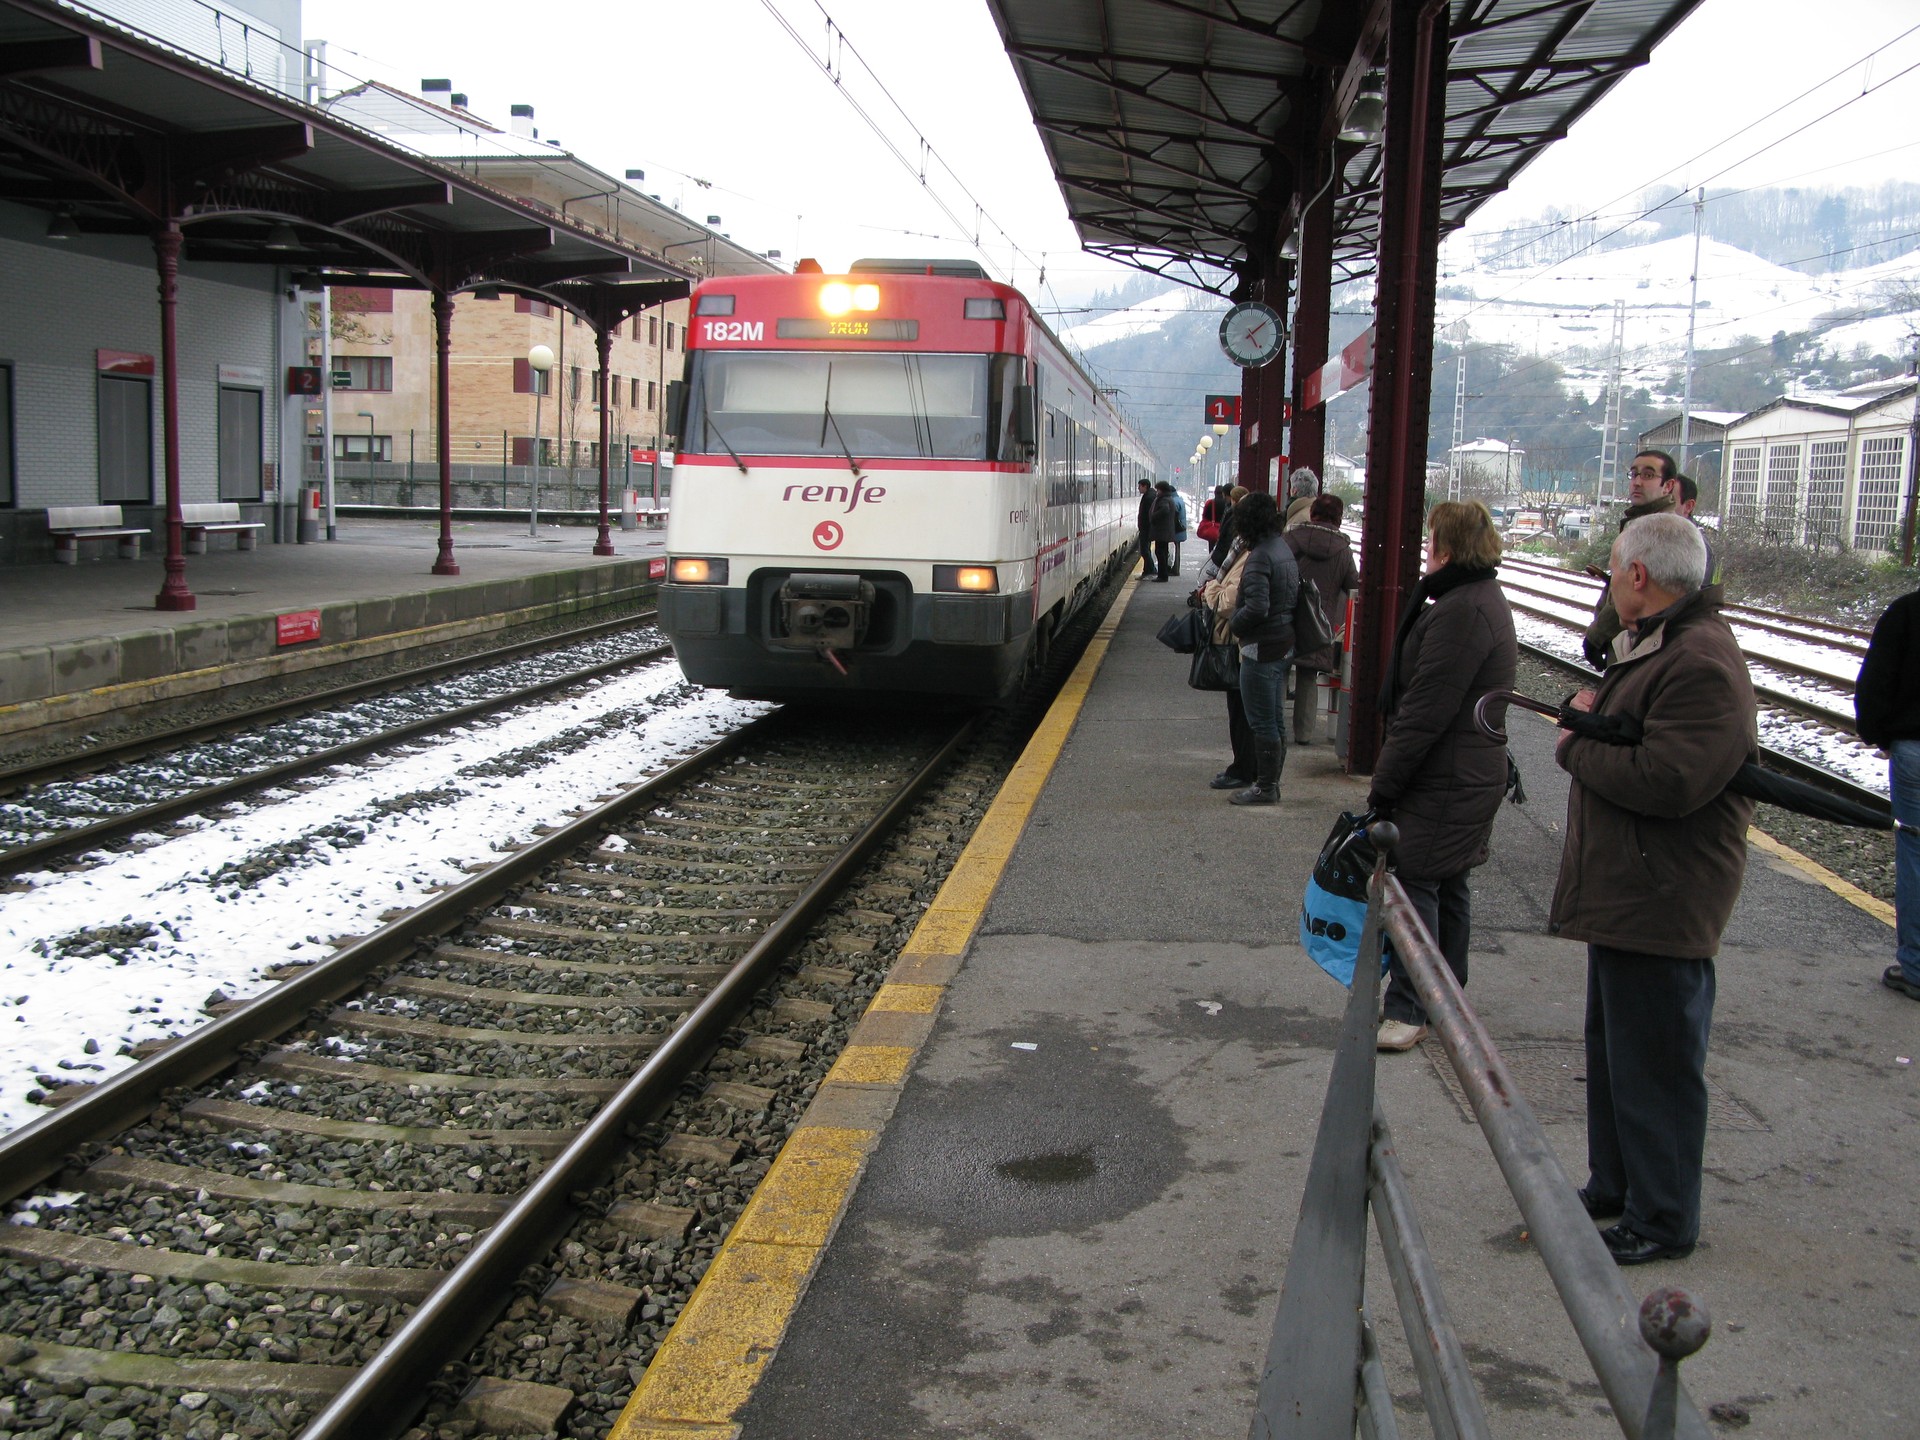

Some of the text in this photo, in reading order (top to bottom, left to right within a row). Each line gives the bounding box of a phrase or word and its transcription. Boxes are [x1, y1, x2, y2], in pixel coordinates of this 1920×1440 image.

[703, 321, 764, 341] 182M
[828, 322, 869, 335] IRUN
[303, 373, 313, 388] 2
[1214, 402, 1225, 418] 1
[782, 475, 886, 514] renfe
[1009, 501, 1030, 532] renfe
